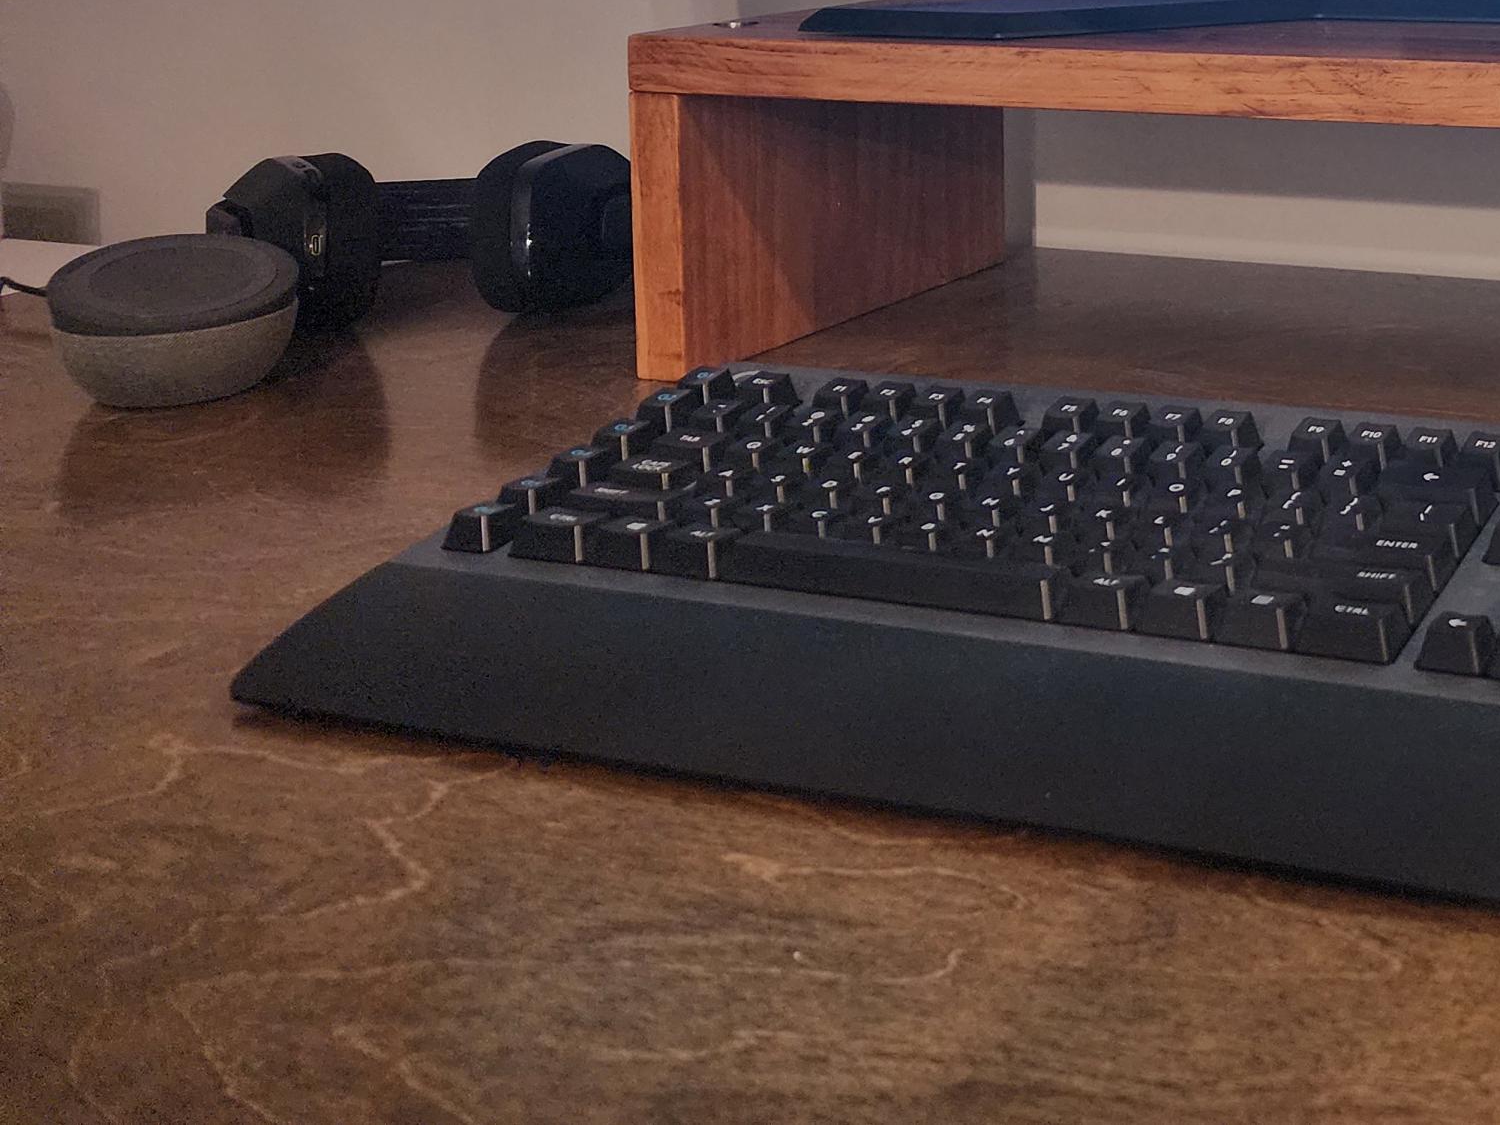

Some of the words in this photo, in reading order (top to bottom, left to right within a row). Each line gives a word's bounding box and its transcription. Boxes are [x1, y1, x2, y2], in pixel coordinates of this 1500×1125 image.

[1112, 408, 1129, 417] F6
[1307, 425, 1325, 433] F9
[1360, 430, 1382, 439] F10
[1418, 435, 1438, 443] F11
[1475, 440, 1496, 449] F12
[1375, 539, 1418, 549] ENTER
[1357, 571, 1396, 580] SHIFT
[1334, 605, 1369, 615] CTRL
